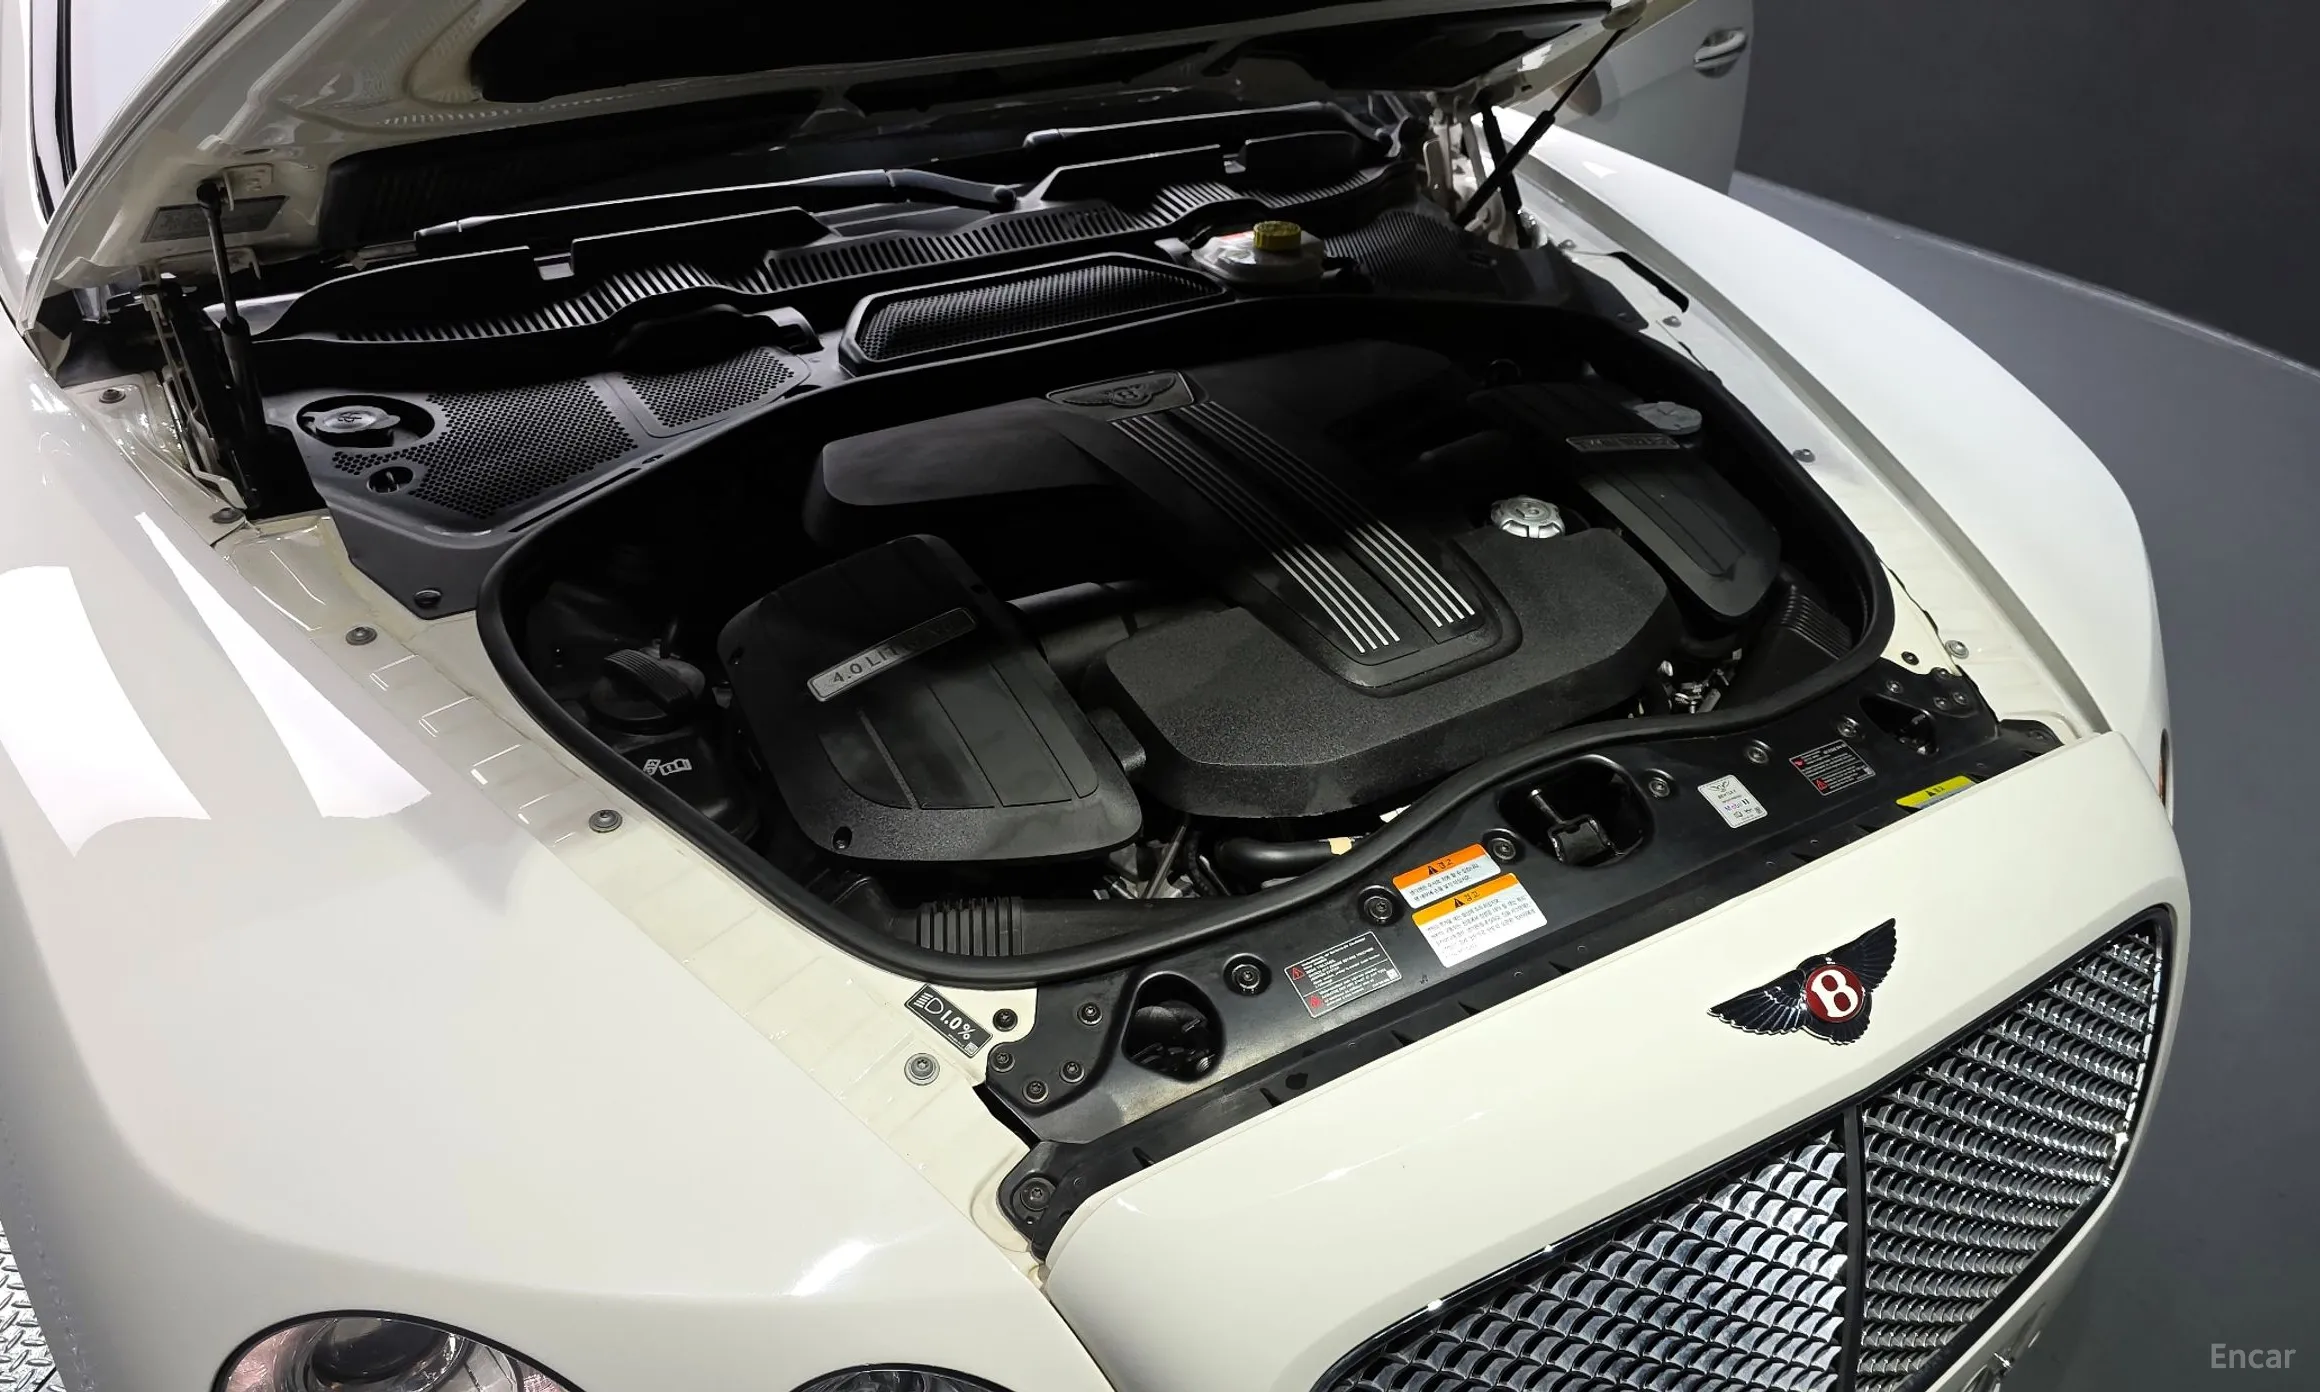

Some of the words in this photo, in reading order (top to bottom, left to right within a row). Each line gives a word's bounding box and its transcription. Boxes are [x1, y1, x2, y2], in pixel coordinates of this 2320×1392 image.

[832, 663, 863, 683] 4.0
[1466, 890, 1481, 902] 경고
[1811, 969, 1859, 1018] B
